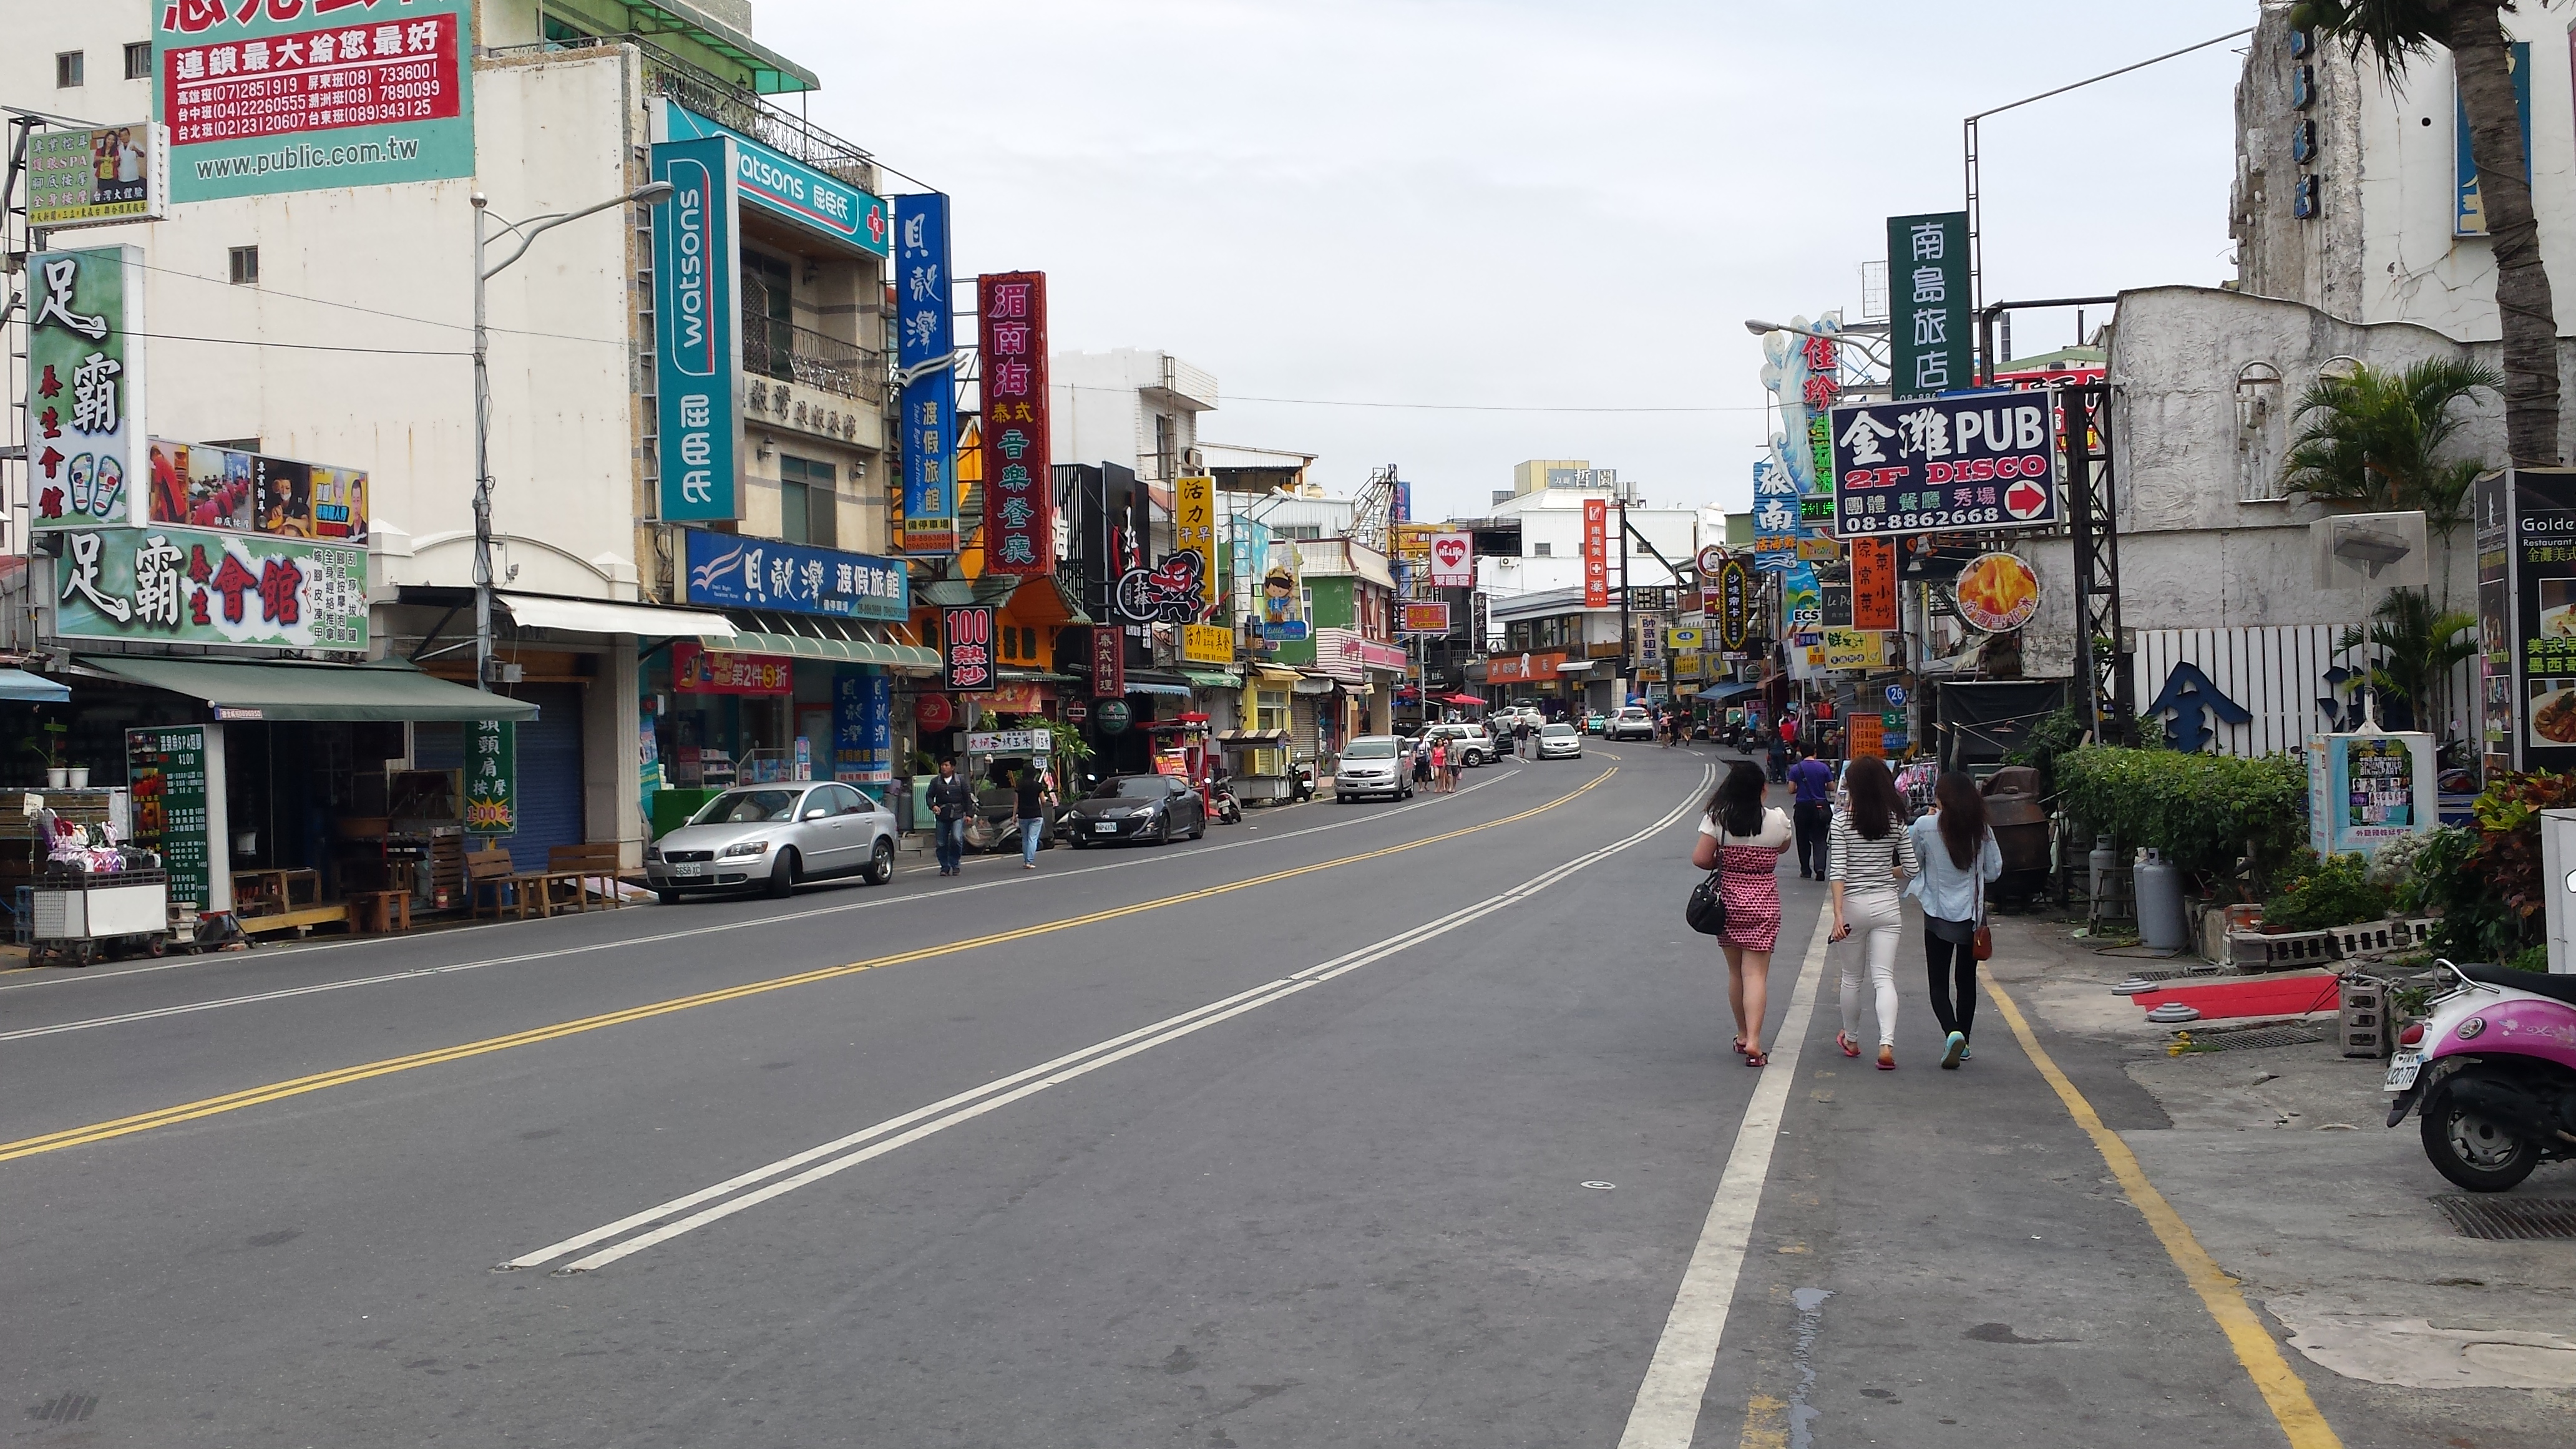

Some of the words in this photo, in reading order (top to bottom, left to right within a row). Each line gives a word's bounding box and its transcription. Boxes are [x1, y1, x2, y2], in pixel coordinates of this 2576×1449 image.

[177, 21, 438, 80] 連鎖最大給您最好
[32, 134, 88, 154] 專業挖耳
[195, 135, 419, 180] www.public.com.tw
[32, 190, 87, 208] 全身按摩
[813, 185, 848, 222] 屈臣氏
[679, 188, 703, 348] watsons
[905, 213, 943, 354] 貝殼灣
[1911, 222, 1949, 389] 南島旅店
[36, 259, 121, 434] 足霸
[988, 283, 1032, 398] 湄南海
[1801, 336, 1840, 412] 佳珍
[991, 401, 1035, 424] 泰式
[32, 364, 65, 519] 養生會館
[680, 394, 711, 503] 屈臣氏
[923, 401, 940, 512] 渡假旅館
[1574, 469, 1613, 487] 哲園
[1845, 466, 1909, 490] 2F
[1926, 455, 2046, 485] DISCO
[997, 429, 1036, 564] 音樂餐廳
[1184, 481, 1204, 523] 活力
[1953, 487, 1997, 507] 秀場
[908, 520, 949, 530] 備停車場
[1847, 507, 1999, 532] 08-8862668
[1591, 526, 1601, 557] 康是美
[2524, 539, 2572, 547] Restaurant
[62, 532, 182, 625] 足霸
[744, 549, 824, 609] 貝殼灣
[837, 563, 900, 600] 渡假旅館
[947, 609, 988, 645] 100
[1795, 610, 1820, 621] ECS
[1642, 618, 1656, 659] 帥哥租車
[732, 663, 787, 688] 第2件5折
[952, 645, 987, 686] 熱炒
[1099, 634, 1113, 691] 泰式料理
[1891, 688, 1903, 700] 26
[178, 753, 195, 765] $100
[472, 778, 507, 796] 按摩
[467, 805, 512, 822] 100元
